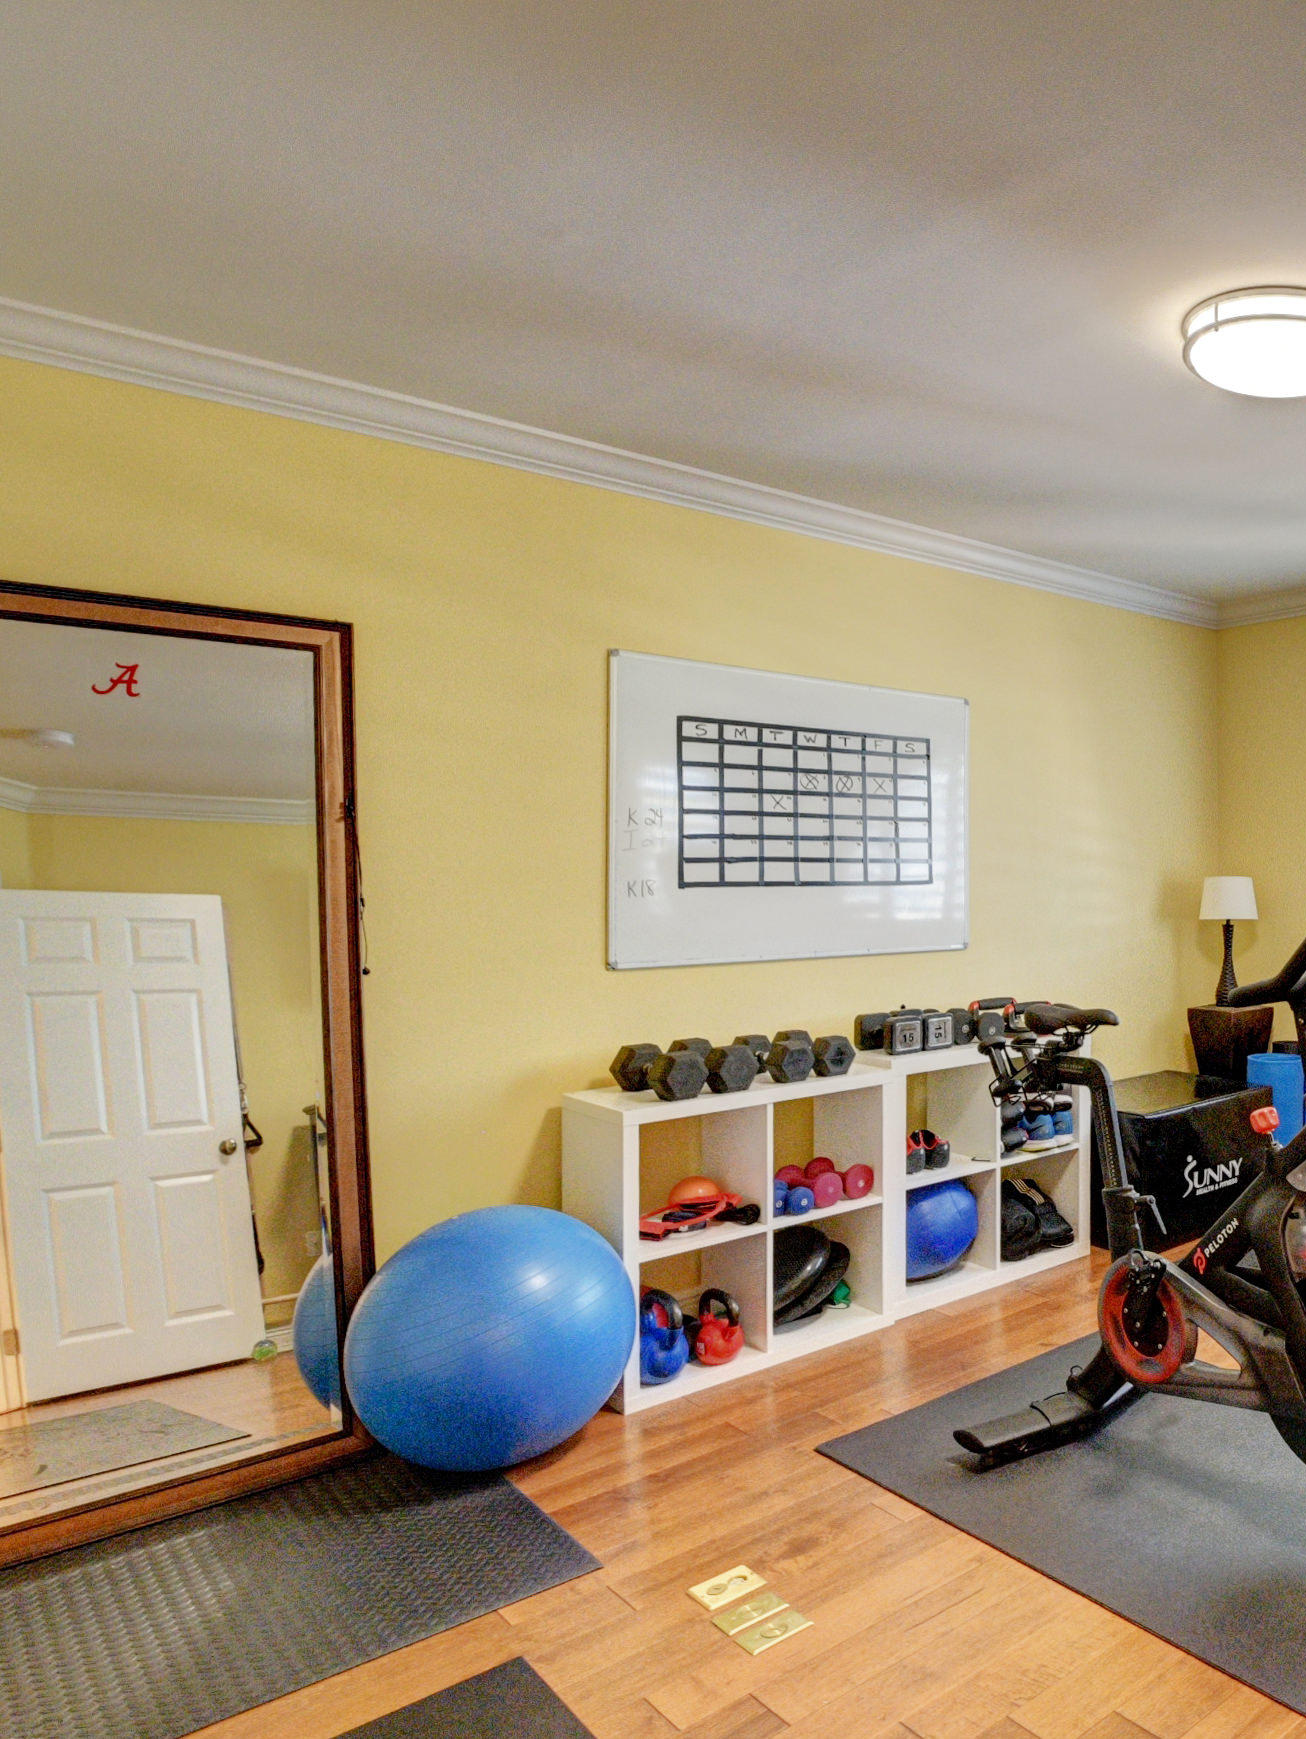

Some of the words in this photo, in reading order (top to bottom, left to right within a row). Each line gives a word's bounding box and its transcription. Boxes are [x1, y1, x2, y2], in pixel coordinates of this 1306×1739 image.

[91, 661, 140, 697] A
[695, 723, 708, 737] S
[734, 727, 748, 740] M
[769, 730, 784, 741] T
[803, 734, 818, 744] W
[838, 736, 851, 747] T
[904, 742, 916, 753] S
[903, 1032, 914, 1043] 15
[934, 1024, 943, 1039] 15
[1182, 1154, 1243, 1198] SUNNY
[1203, 1217, 1240, 1258] PELOTON
